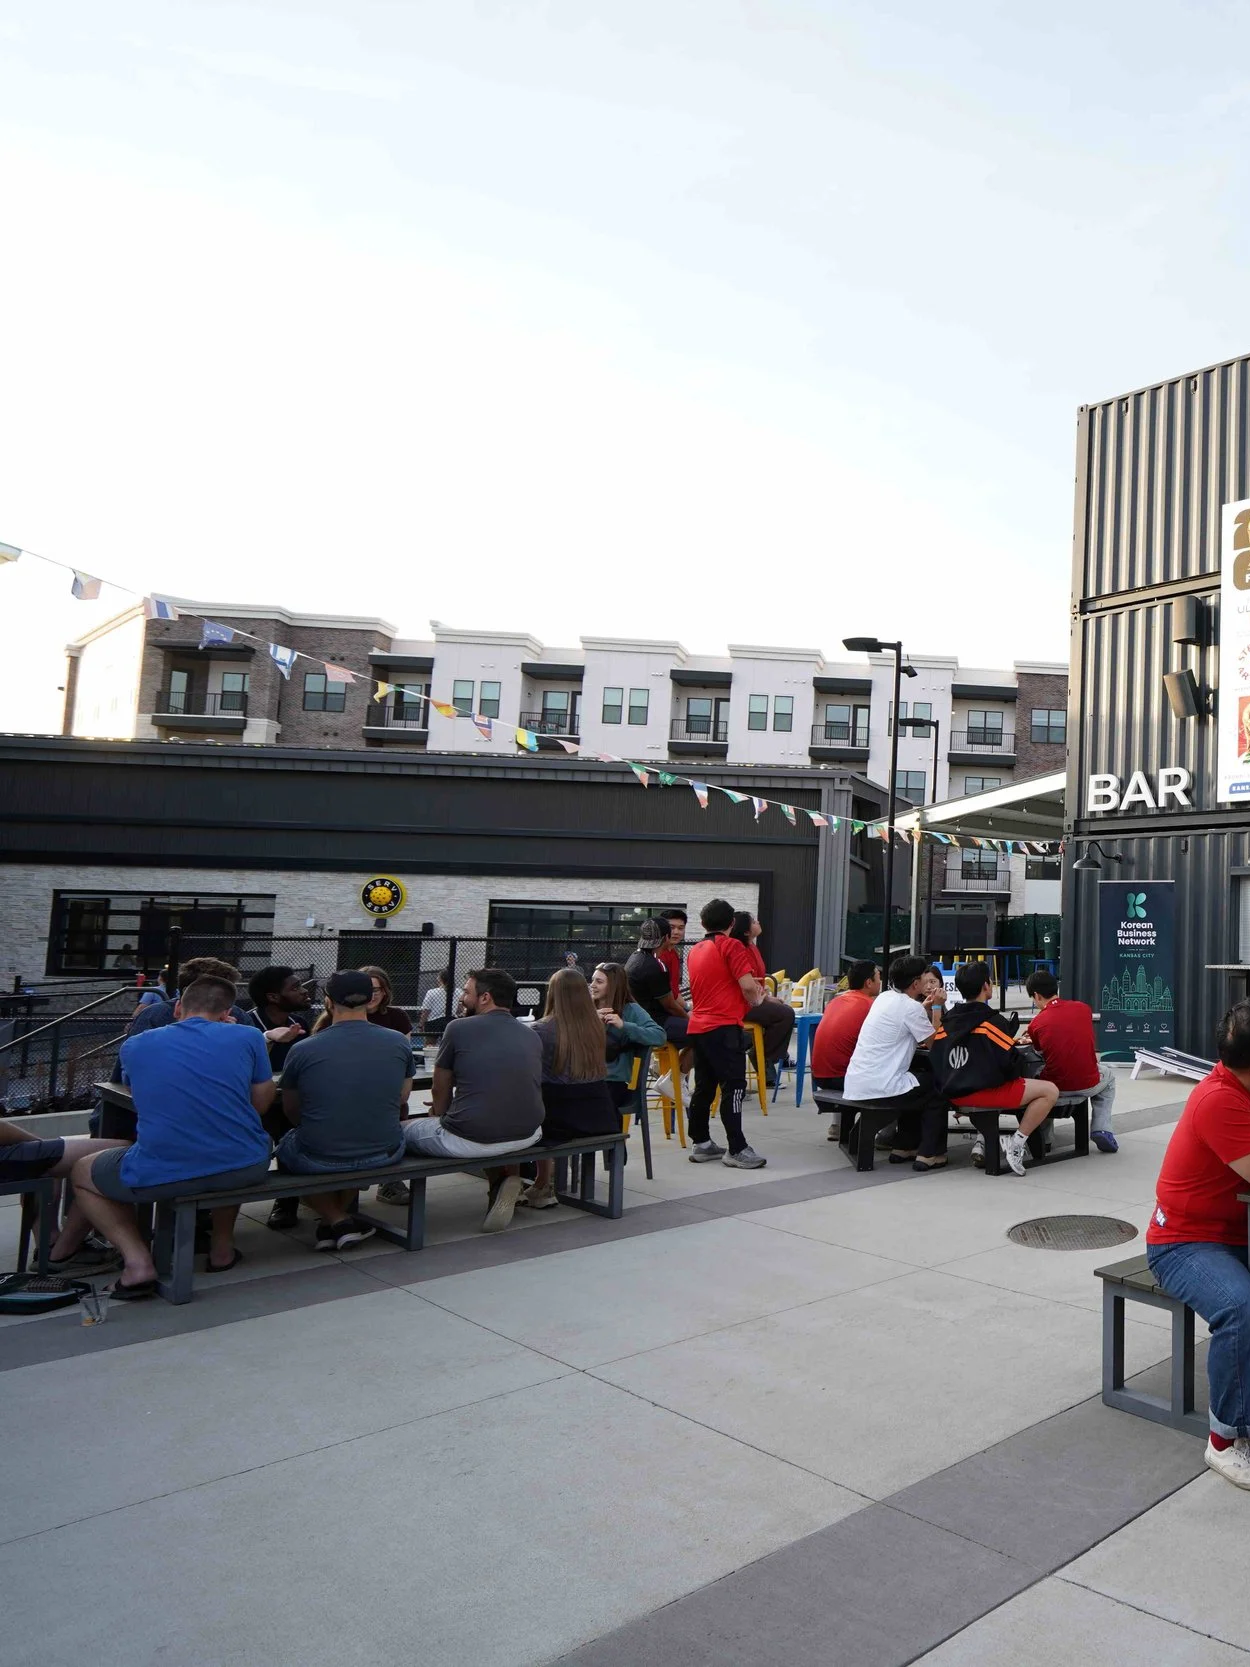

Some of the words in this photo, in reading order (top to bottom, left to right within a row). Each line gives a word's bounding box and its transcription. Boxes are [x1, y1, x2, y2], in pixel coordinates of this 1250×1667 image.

[1088, 767, 1191, 811] BAR
[368, 881, 397, 891] SERV
[366, 901, 395, 912] SERV
[1120, 921, 1153, 929] Korean
[1118, 937, 1156, 946] Network
